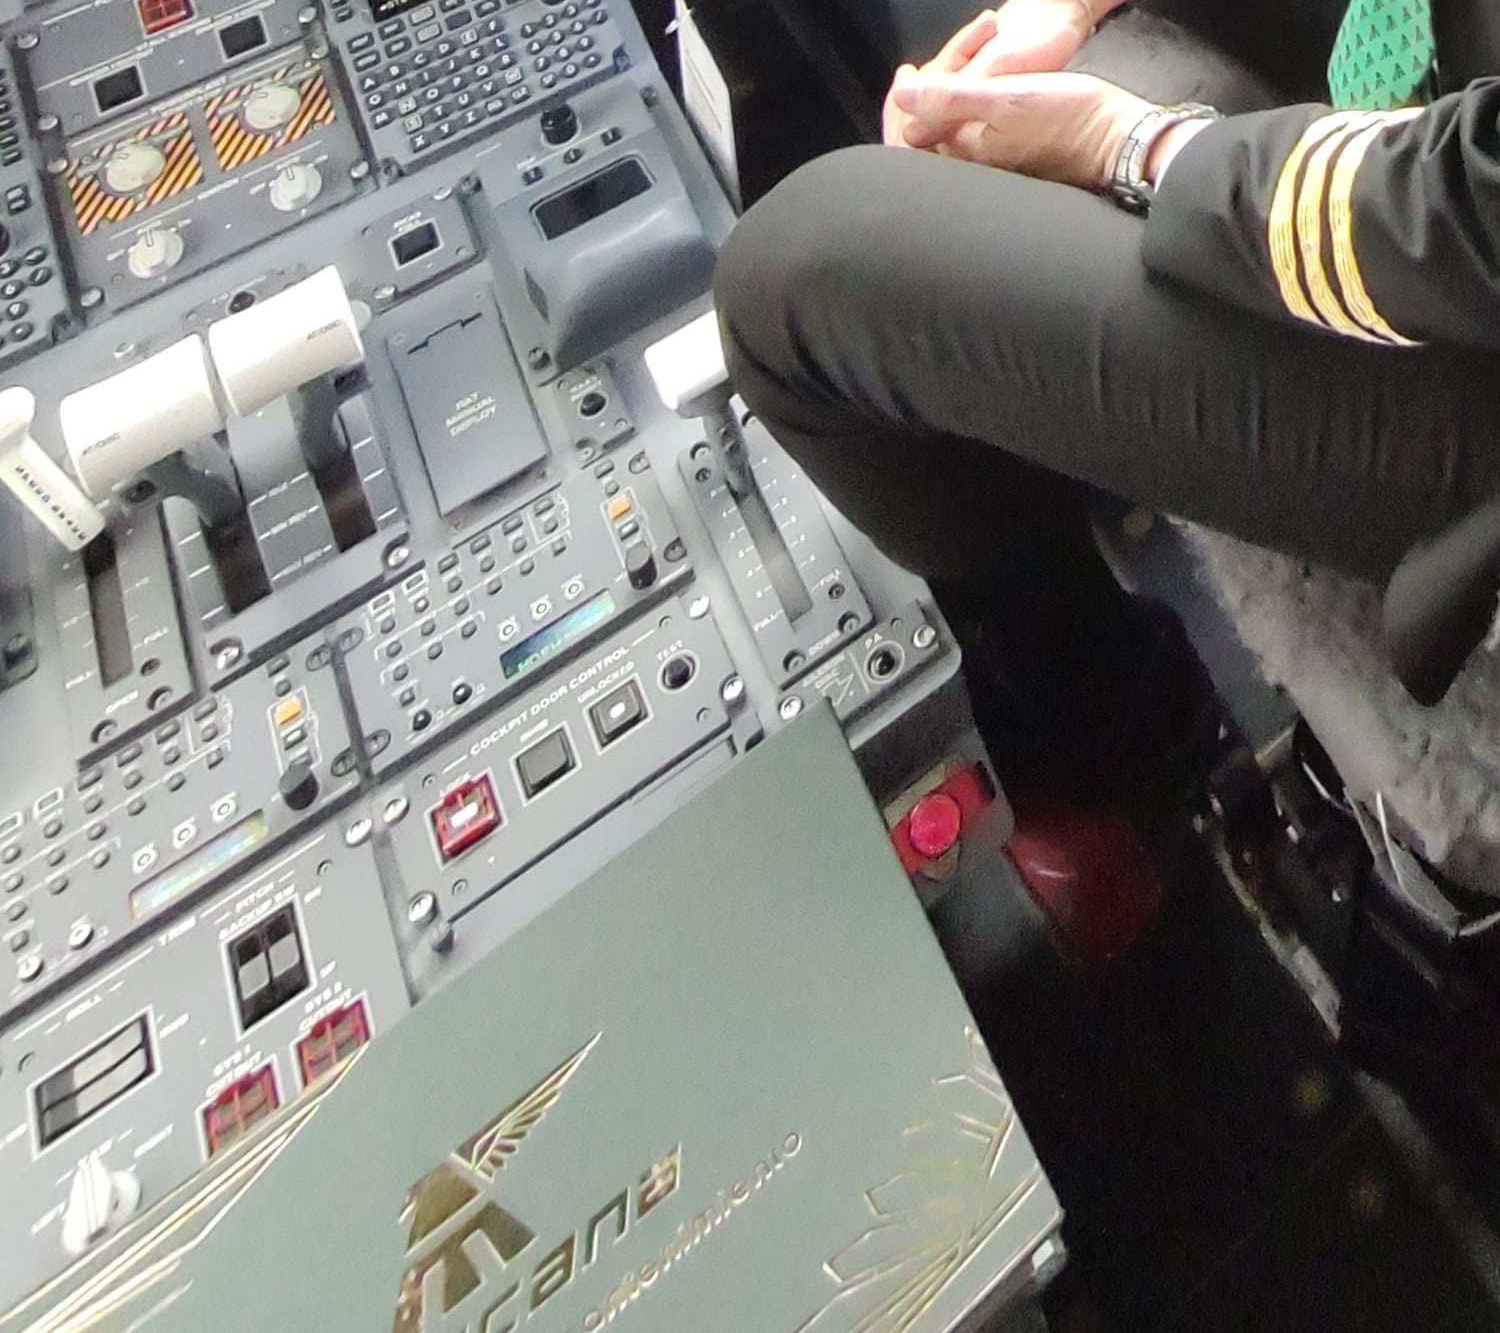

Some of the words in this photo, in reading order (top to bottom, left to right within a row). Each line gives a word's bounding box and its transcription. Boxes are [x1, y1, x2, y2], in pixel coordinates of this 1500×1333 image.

[469, 47, 482, 60] K
[364, 77, 376, 88] A
[414, 53, 427, 64] C
[426, 87, 439, 100] O
[434, 105, 445, 117] T
[457, 93, 470, 105] U
[482, 81, 494, 92] V
[414, 134, 426, 147] X
[440, 122, 450, 134] Y
[465, 110, 477, 122] Z
[445, 395, 497, 429] MANUAL
[456, 390, 480, 411] RAT
[449, 404, 498, 437] DEPLOY
[657, 638, 684, 662] TEST
[865, 632, 883, 651] PA
[576, 660, 636, 704] UNLOCKED
[104, 690, 140, 715] OPEN
[469, 710, 529, 757] COCKPIT
[529, 686, 569, 717] DOOR
[568, 645, 631, 690] CONTROL
[235, 881, 275, 913] PITCH
[157, 914, 197, 948] TRIM
[218, 897, 275, 942] BACKUP
[65, 993, 103, 1022] ROLL
[304, 989, 334, 1013] SYS
[213, 1050, 243, 1077] SYS
[463, 1141, 682, 1333] cana
